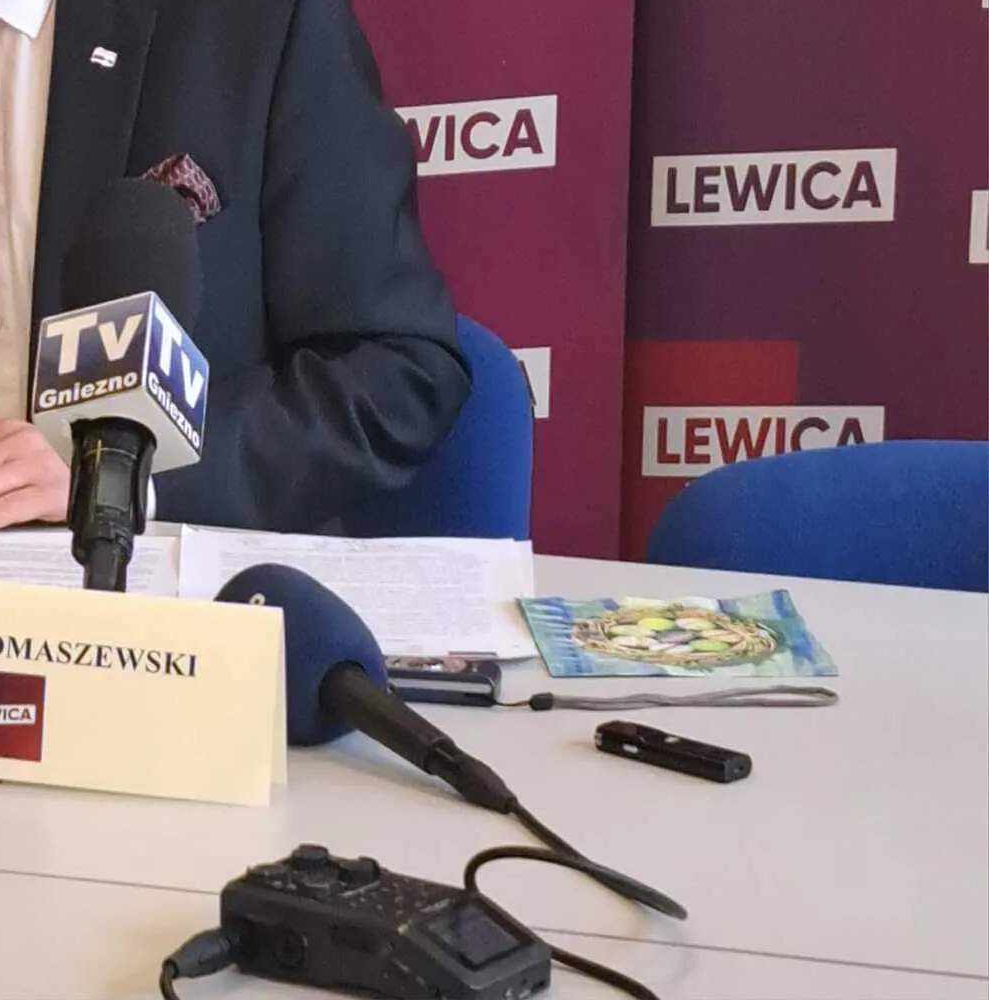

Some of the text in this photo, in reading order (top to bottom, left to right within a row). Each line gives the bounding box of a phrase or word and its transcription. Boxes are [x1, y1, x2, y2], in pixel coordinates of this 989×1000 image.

[666, 161, 881, 214] LEWICA
[39, 372, 138, 409] Gniezno
[148, 371, 200, 448] Gniezno
